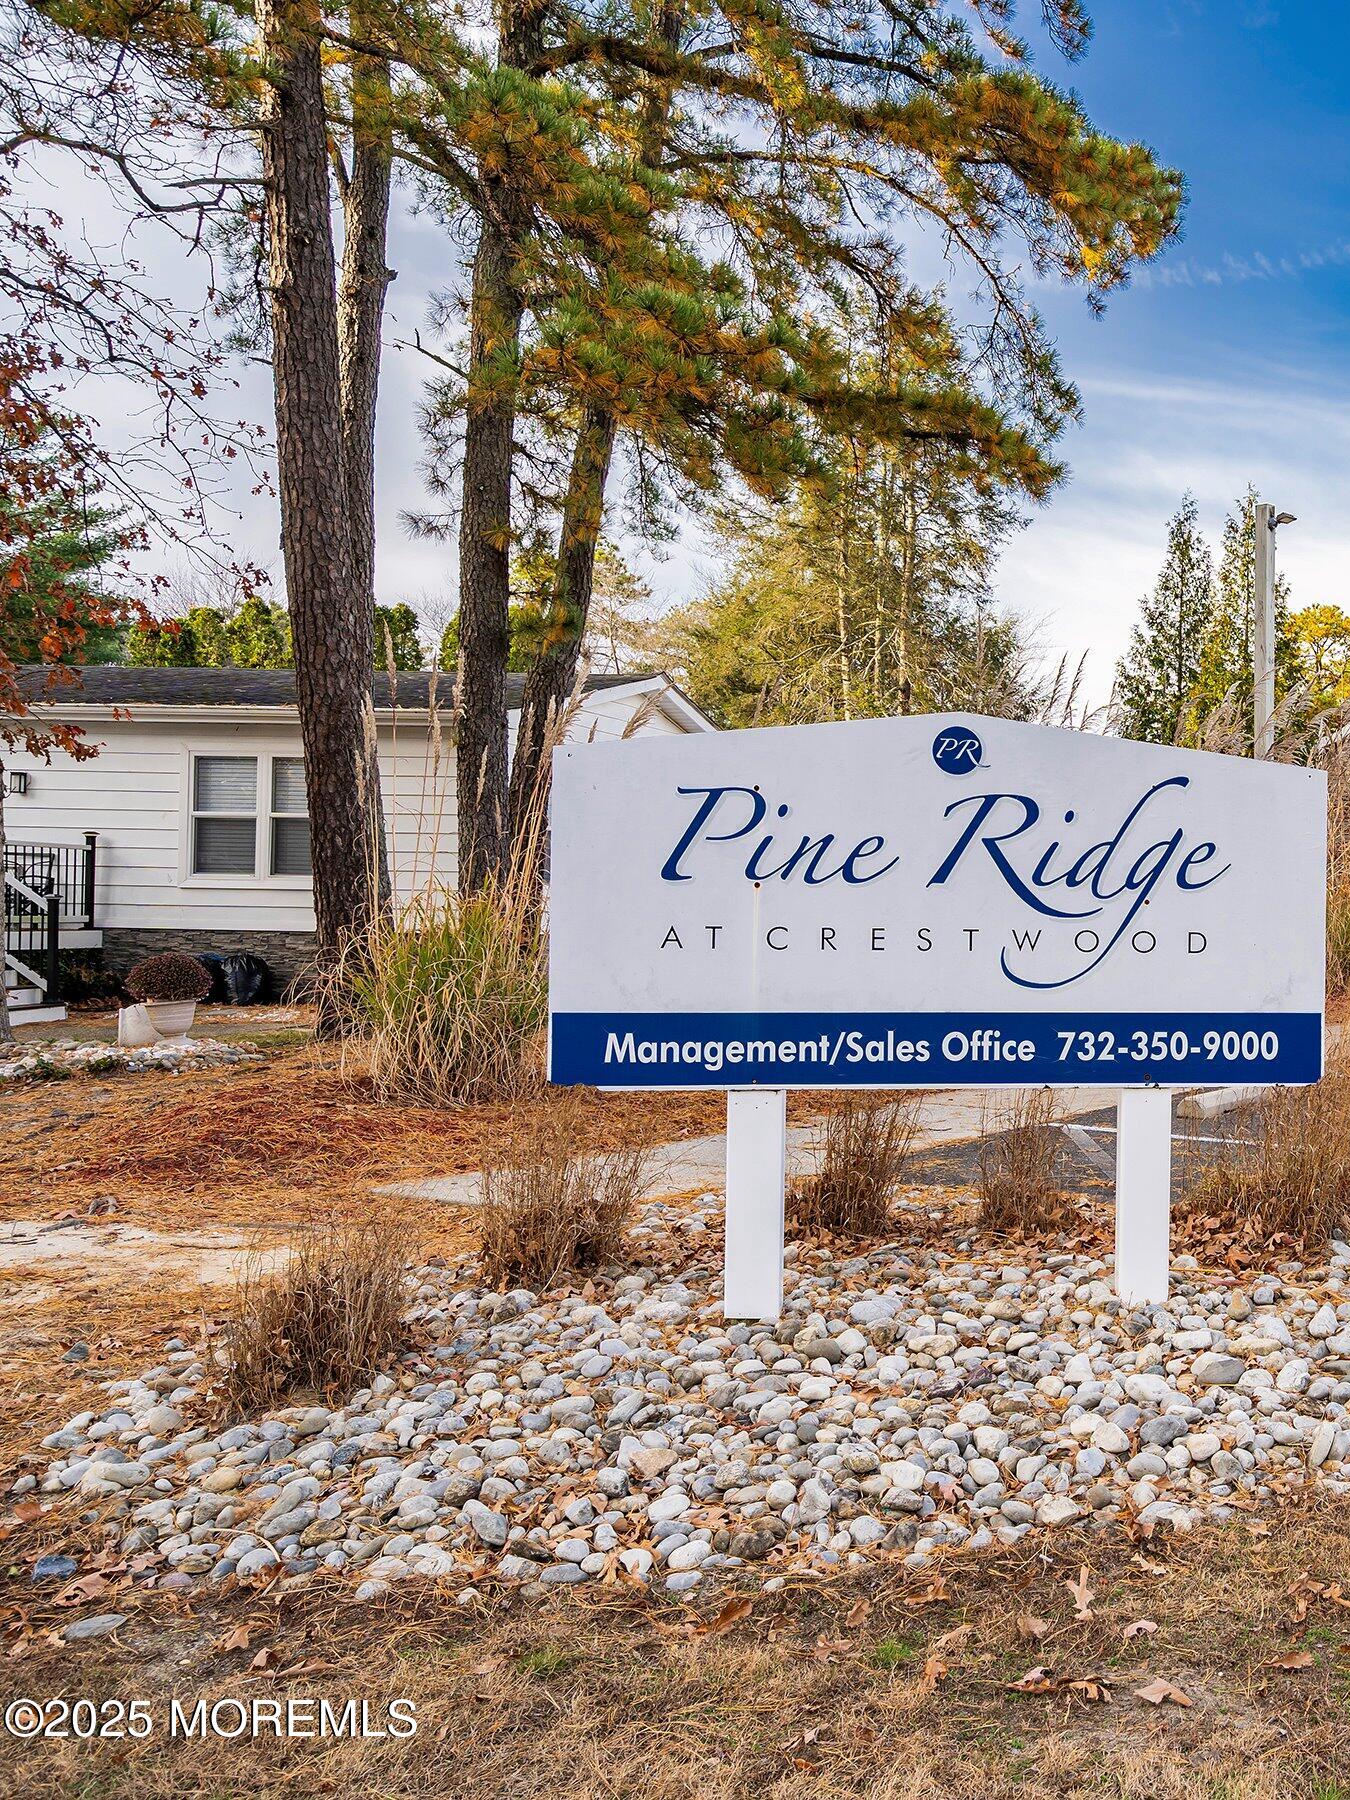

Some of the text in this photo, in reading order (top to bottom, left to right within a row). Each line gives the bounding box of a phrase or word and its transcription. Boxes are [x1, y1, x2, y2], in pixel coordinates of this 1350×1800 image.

[936, 737, 991, 768] PR
[661, 776, 1231, 989] Pine Ridge
[660, 925, 1208, 954] AT CRESTWOOD
[604, 1029, 1280, 1071] Management/Sales Office 732-350-9000
